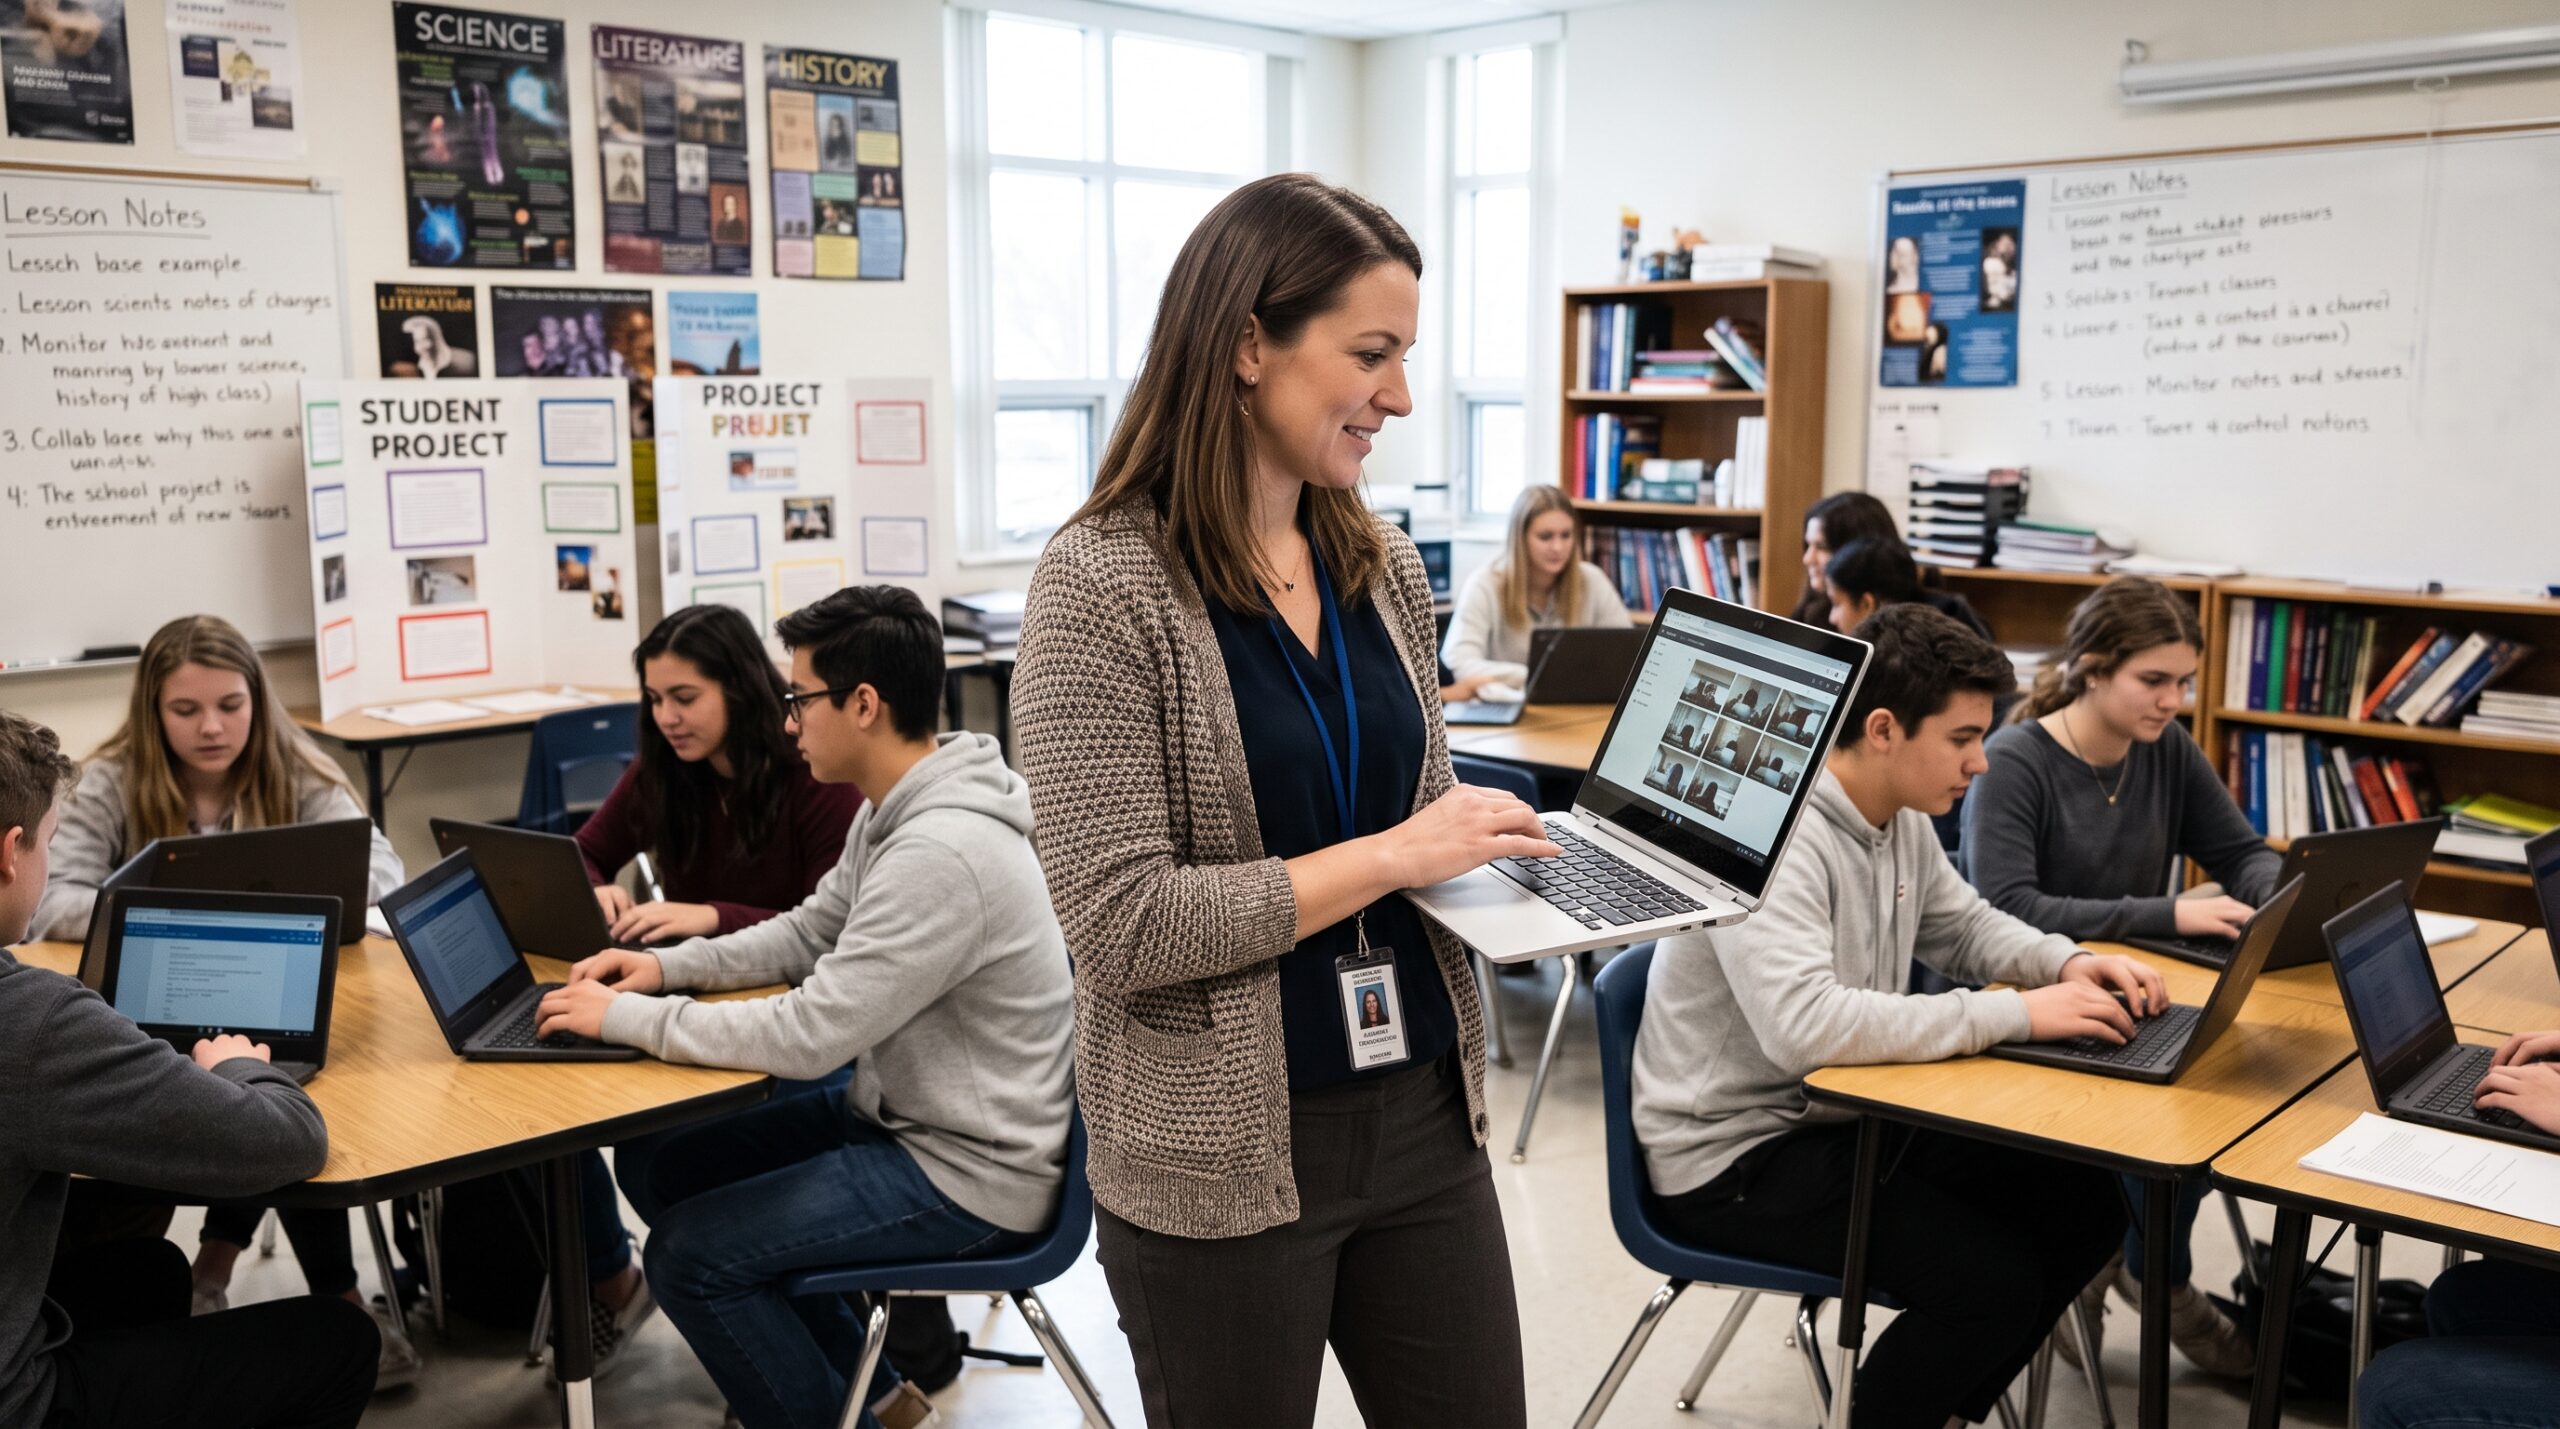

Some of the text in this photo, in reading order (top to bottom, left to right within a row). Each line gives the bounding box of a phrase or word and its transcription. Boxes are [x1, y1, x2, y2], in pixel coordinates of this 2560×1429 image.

[415, 11, 549, 54] SCIENCE
[597, 32, 741, 73] LITERATURE
[779, 53, 888, 89] HISTORY
[2050, 169, 2187, 202] Lesson Notes
[3, 190, 206, 228] Lesson Notes
[95, 250, 143, 273] base
[18, 291, 92, 314] Lesson
[183, 292, 230, 309] notes
[22, 332, 107, 354] Monitor
[240, 329, 273, 348] and
[143, 361, 164, 382] by
[2290, 365, 2322, 386] and
[57, 386, 128, 412] history
[168, 387, 207, 408] high
[703, 383, 821, 407] PROJECT
[360, 399, 502, 424] STUDENT
[2, 428, 25, 452] 3.
[31, 427, 97, 451] Collab
[155, 427, 192, 448] why
[372, 432, 508, 459] PROJECT
[37, 482, 75, 505] The
[85, 481, 147, 502] school
[159, 476, 222, 505] project
[233, 476, 251, 495] is
[196, 510, 232, 523] new
